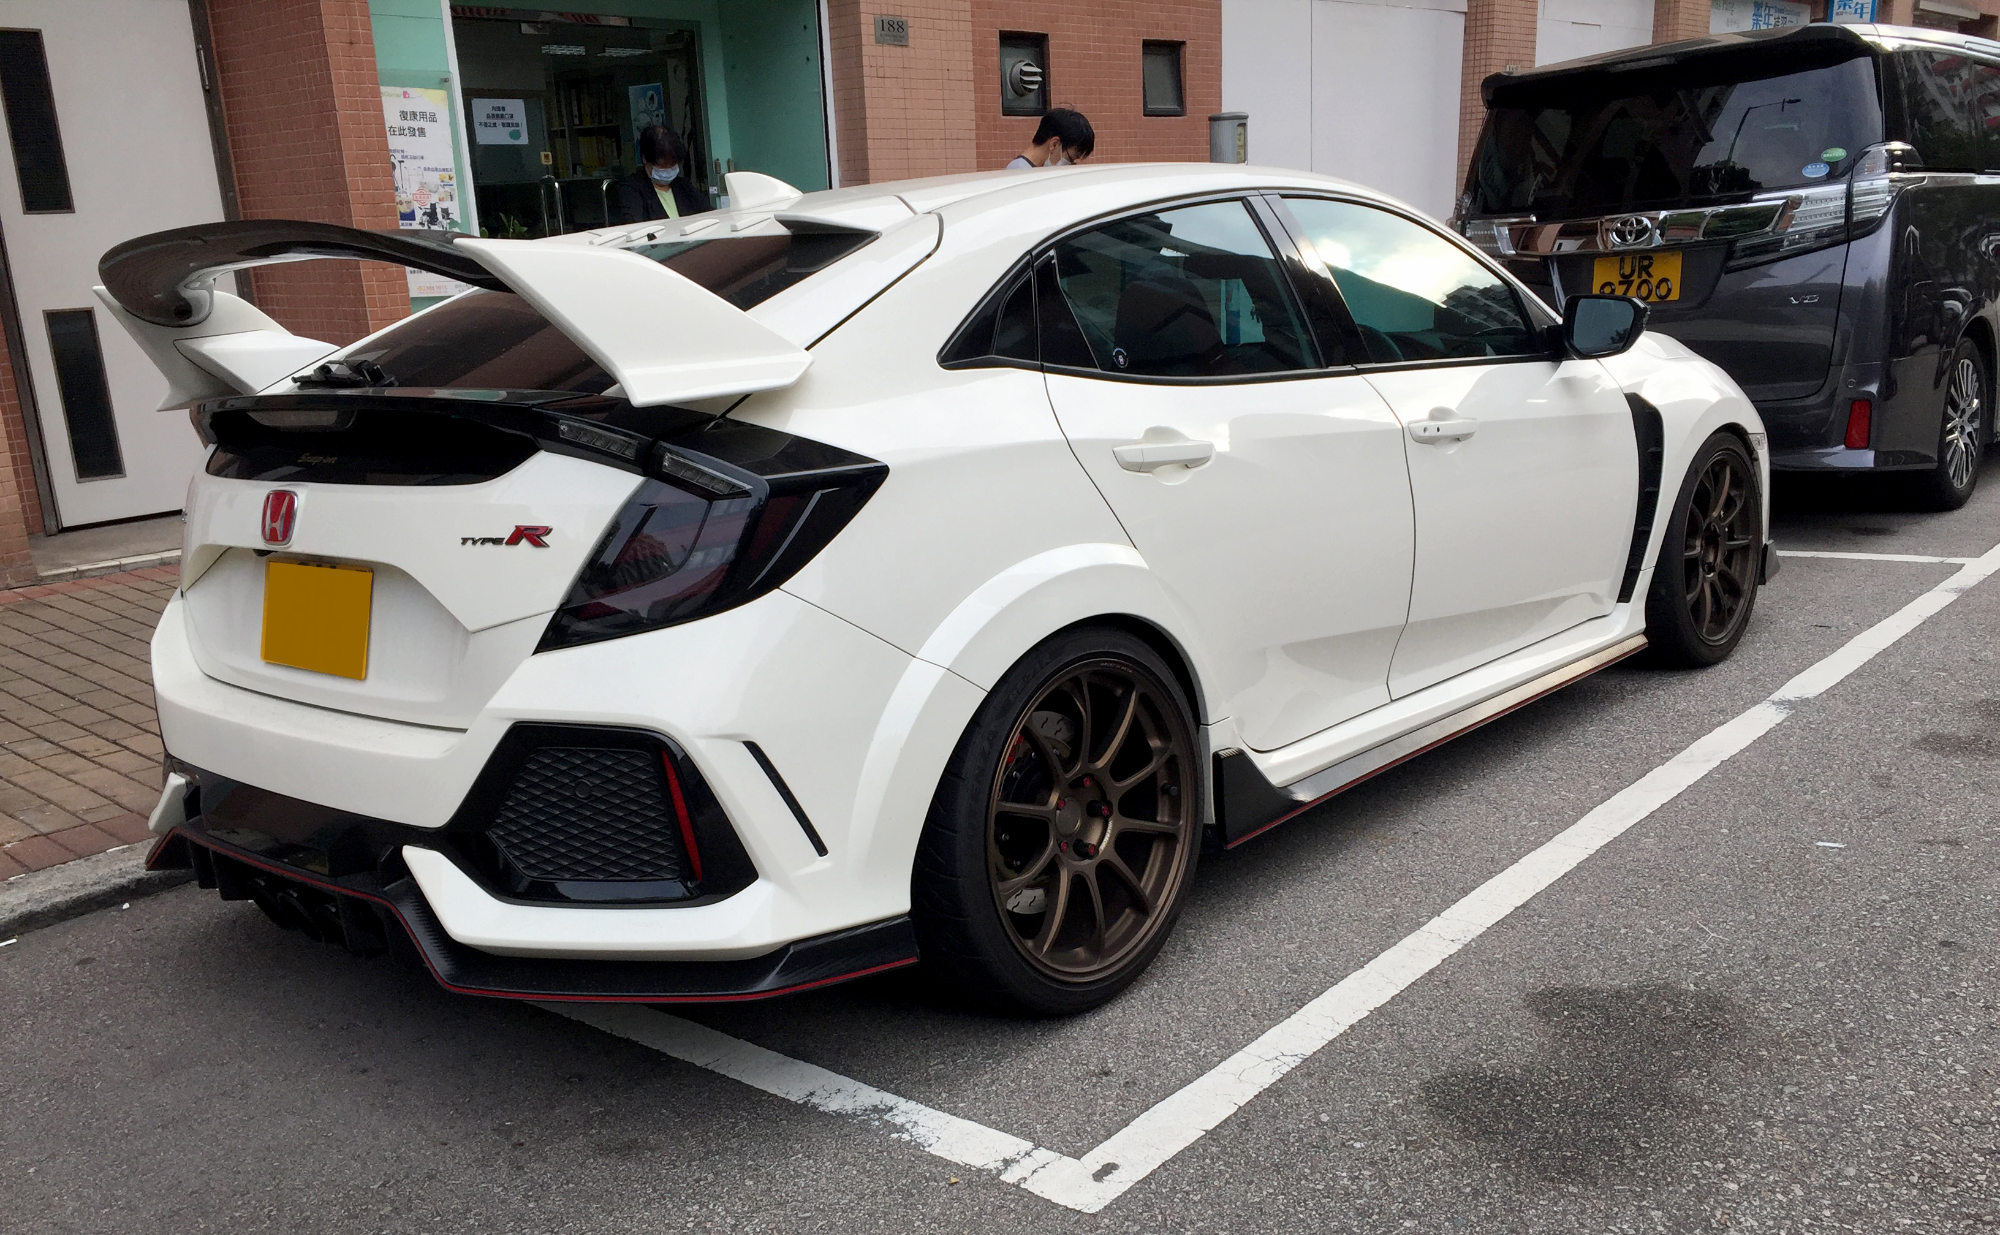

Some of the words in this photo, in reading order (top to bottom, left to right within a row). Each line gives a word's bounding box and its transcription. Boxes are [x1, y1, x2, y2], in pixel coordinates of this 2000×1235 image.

[880, 19, 905, 33] 188
[399, 110, 437, 123] 復康用品
[388, 125, 426, 137] 在此發售
[1619, 255, 1654, 279] UR
[1789, 294, 1819, 304] V6
[461, 537, 505, 546] TYPE
[505, 525, 553, 548] R
